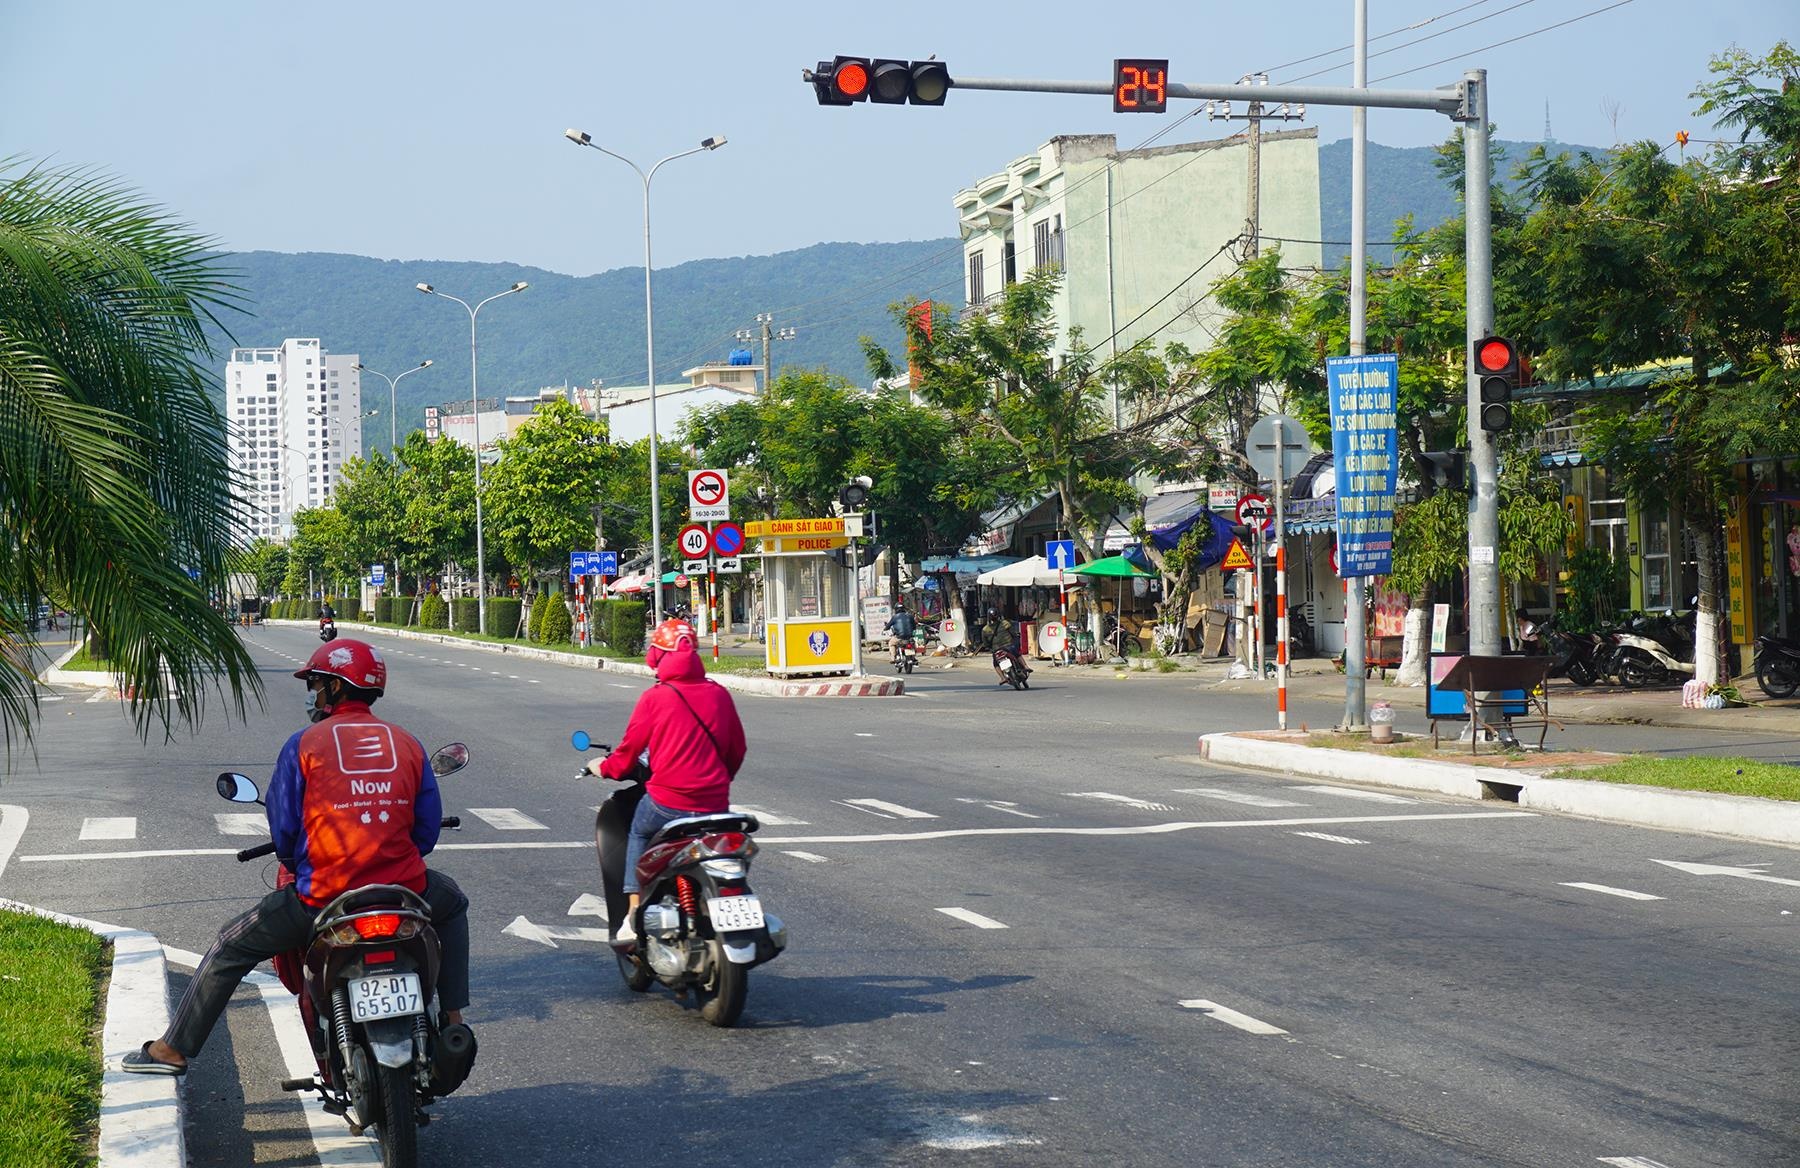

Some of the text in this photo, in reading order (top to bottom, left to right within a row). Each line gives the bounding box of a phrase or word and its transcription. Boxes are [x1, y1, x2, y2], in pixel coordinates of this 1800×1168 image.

[1119, 67, 1164, 106] 24
[1338, 368, 1362, 390] TUYẾN
[1358, 390, 1373, 410] CÁC
[1335, 415, 1345, 431] XE
[1360, 431, 1376, 450] CÁC
[1376, 434, 1386, 450] XE
[796, 520, 811, 532] SÁT
[814, 521, 833, 532] GIAO
[688, 534, 702, 549] 40
[798, 538, 831, 550] POLICE
[351, 779, 391, 795] Now
[360, 977, 408, 998] 92-D1
[356, 994, 418, 1017] 655.07
